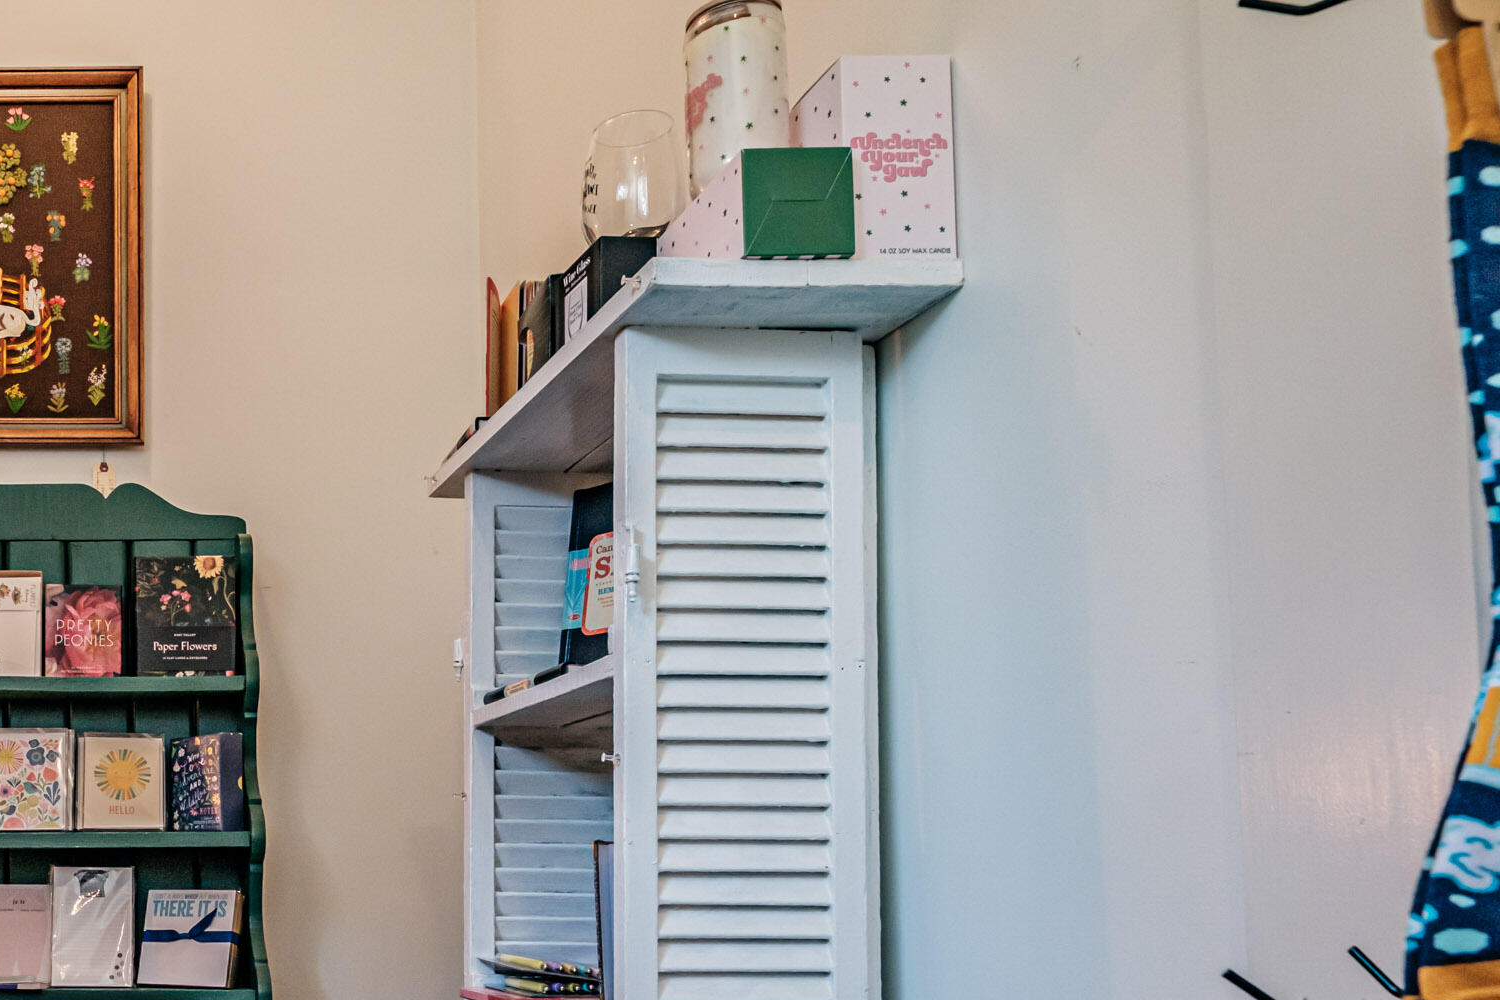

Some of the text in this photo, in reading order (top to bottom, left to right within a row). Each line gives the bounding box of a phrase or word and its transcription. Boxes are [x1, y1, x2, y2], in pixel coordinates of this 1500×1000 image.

[56, 619, 112, 631] PRETTY
[54, 634, 114, 647] PEONIES
[153, 641, 218, 653] Paper Flowers
[109, 805, 135, 815] HELLO
[153, 900, 196, 917] THERE
[198, 901, 212, 917] IT
